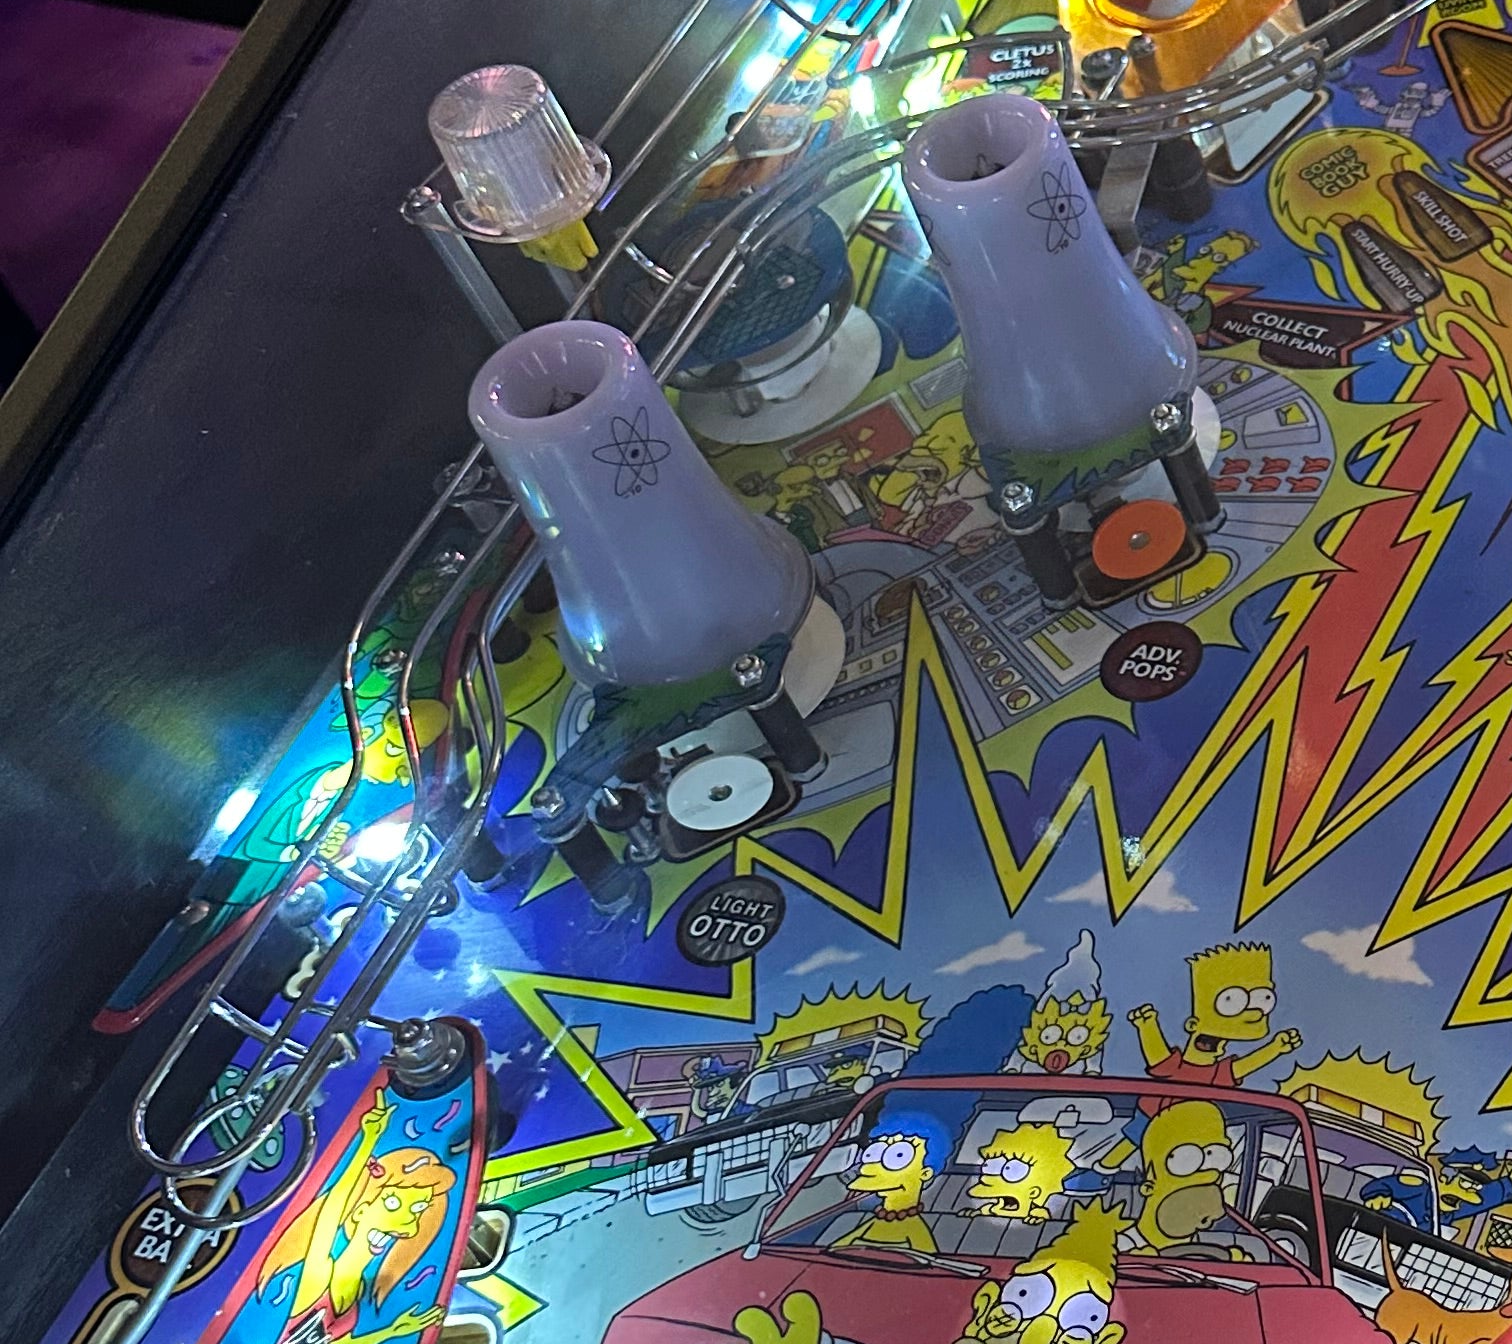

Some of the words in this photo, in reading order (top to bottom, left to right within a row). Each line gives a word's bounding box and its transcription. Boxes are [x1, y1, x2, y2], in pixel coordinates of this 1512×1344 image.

[989, 43, 1055, 63] CLETUS
[986, 66, 1050, 84] SCORING
[1298, 145, 1358, 180] COMIC
[1311, 157, 1363, 190] BOOK
[1318, 164, 1371, 199] GUY
[1412, 190, 1443, 224] SKILL
[1437, 215, 1469, 244] SHOT
[1350, 227, 1378, 260] START
[1223, 319, 1289, 347] NUCLEAR
[1250, 310, 1329, 341] COLLECT
[1129, 643, 1183, 665] ADV.
[1118, 659, 1178, 682] POPS
[710, 894, 774, 919] LIGHT
[689, 913, 767, 947] OTTO
